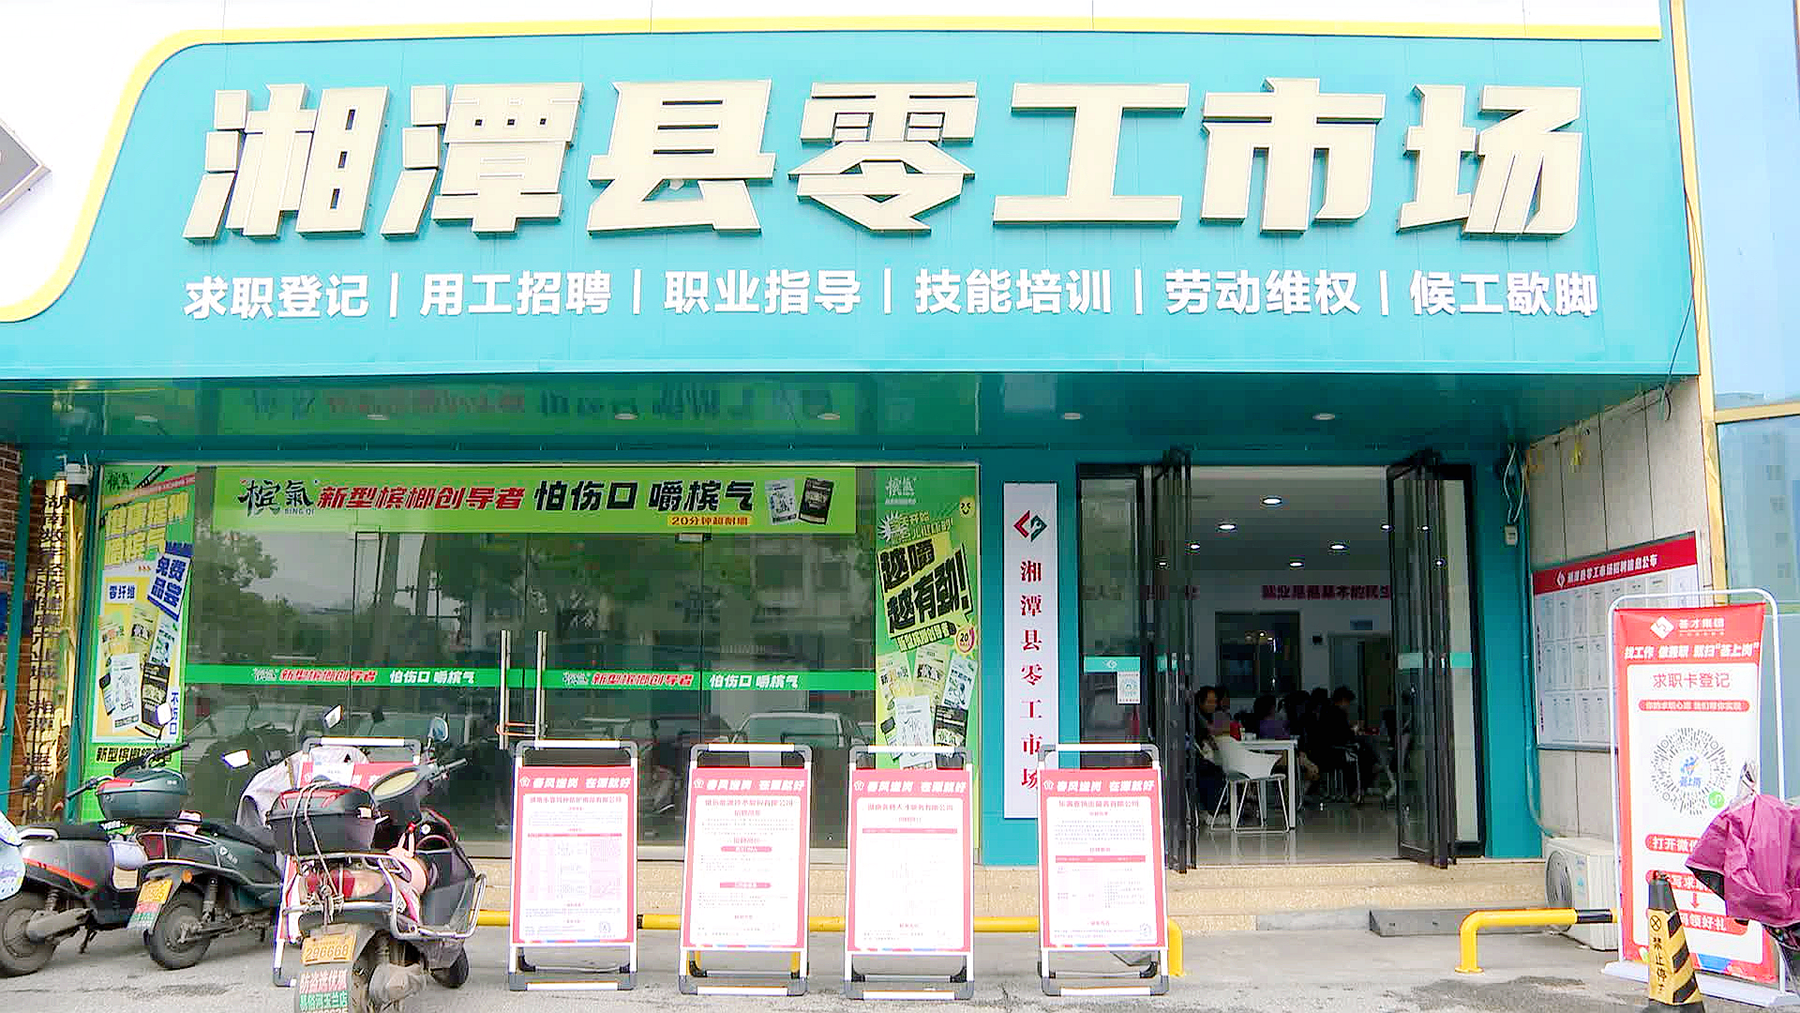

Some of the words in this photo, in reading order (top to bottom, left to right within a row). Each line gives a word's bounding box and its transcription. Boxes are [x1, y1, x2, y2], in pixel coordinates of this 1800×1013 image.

[182, 77, 1583, 240] 湘潭县零工市场
[183, 273, 370, 319] 求职登记
[420, 269, 612, 316] 用工招聘
[663, 269, 861, 314] 职业指导
[915, 268, 1111, 314] 技能培训
[1165, 269, 1361, 315] 劳动维权
[1410, 270, 1598, 318] 候工歇脚
[316, 485, 526, 511] 新型槟榔创导者
[535, 479, 639, 511] 怕伤口
[648, 479, 756, 511] 嚼槟气
[156, 556, 186, 582] 免费
[109, 584, 135, 599] 零纤维
[390, 670, 431, 684] 怕伤口
[709, 674, 752, 688] 怕伤口
[1020, 560, 1042, 789] 湘潭县零工市场
[1653, 672, 1730, 688] 求职卡登记
